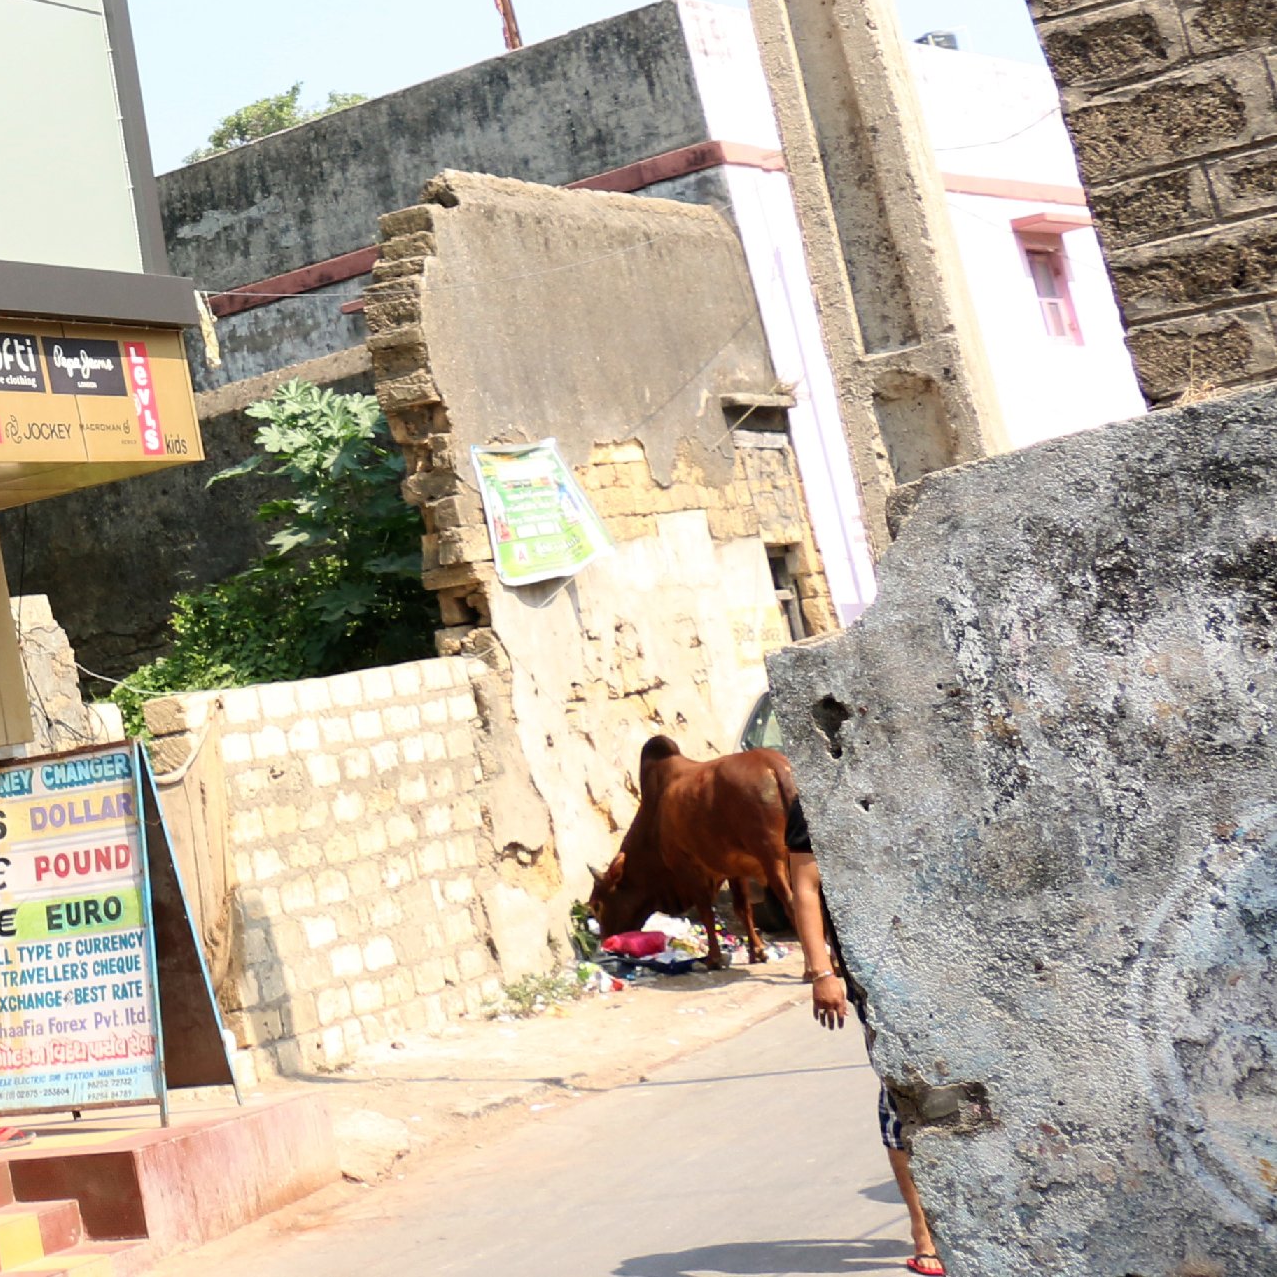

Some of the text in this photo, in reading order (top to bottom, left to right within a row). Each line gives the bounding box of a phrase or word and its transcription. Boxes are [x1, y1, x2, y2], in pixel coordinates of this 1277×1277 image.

[5, 374, 38, 388] clothing
[24, 423, 72, 440] JOCKEY
[164, 434, 188, 455] kids
[41, 753, 133, 790] CHANGER
[29, 792, 134, 831] DOLLAR
[34, 844, 131, 881] POUND
[46, 895, 122, 931] EURO
[17, 944, 52, 962] TYPE
[57, 942, 72, 958] OF
[75, 931, 144, 956] CURRENCY
[1, 960, 89, 987] TRAVELLER'S
[92, 955, 142, 974] CHEQUE
[74, 985, 107, 1006] BEST
[112, 980, 143, 1000] RATE
[49, 1017, 87, 1034] Forex
